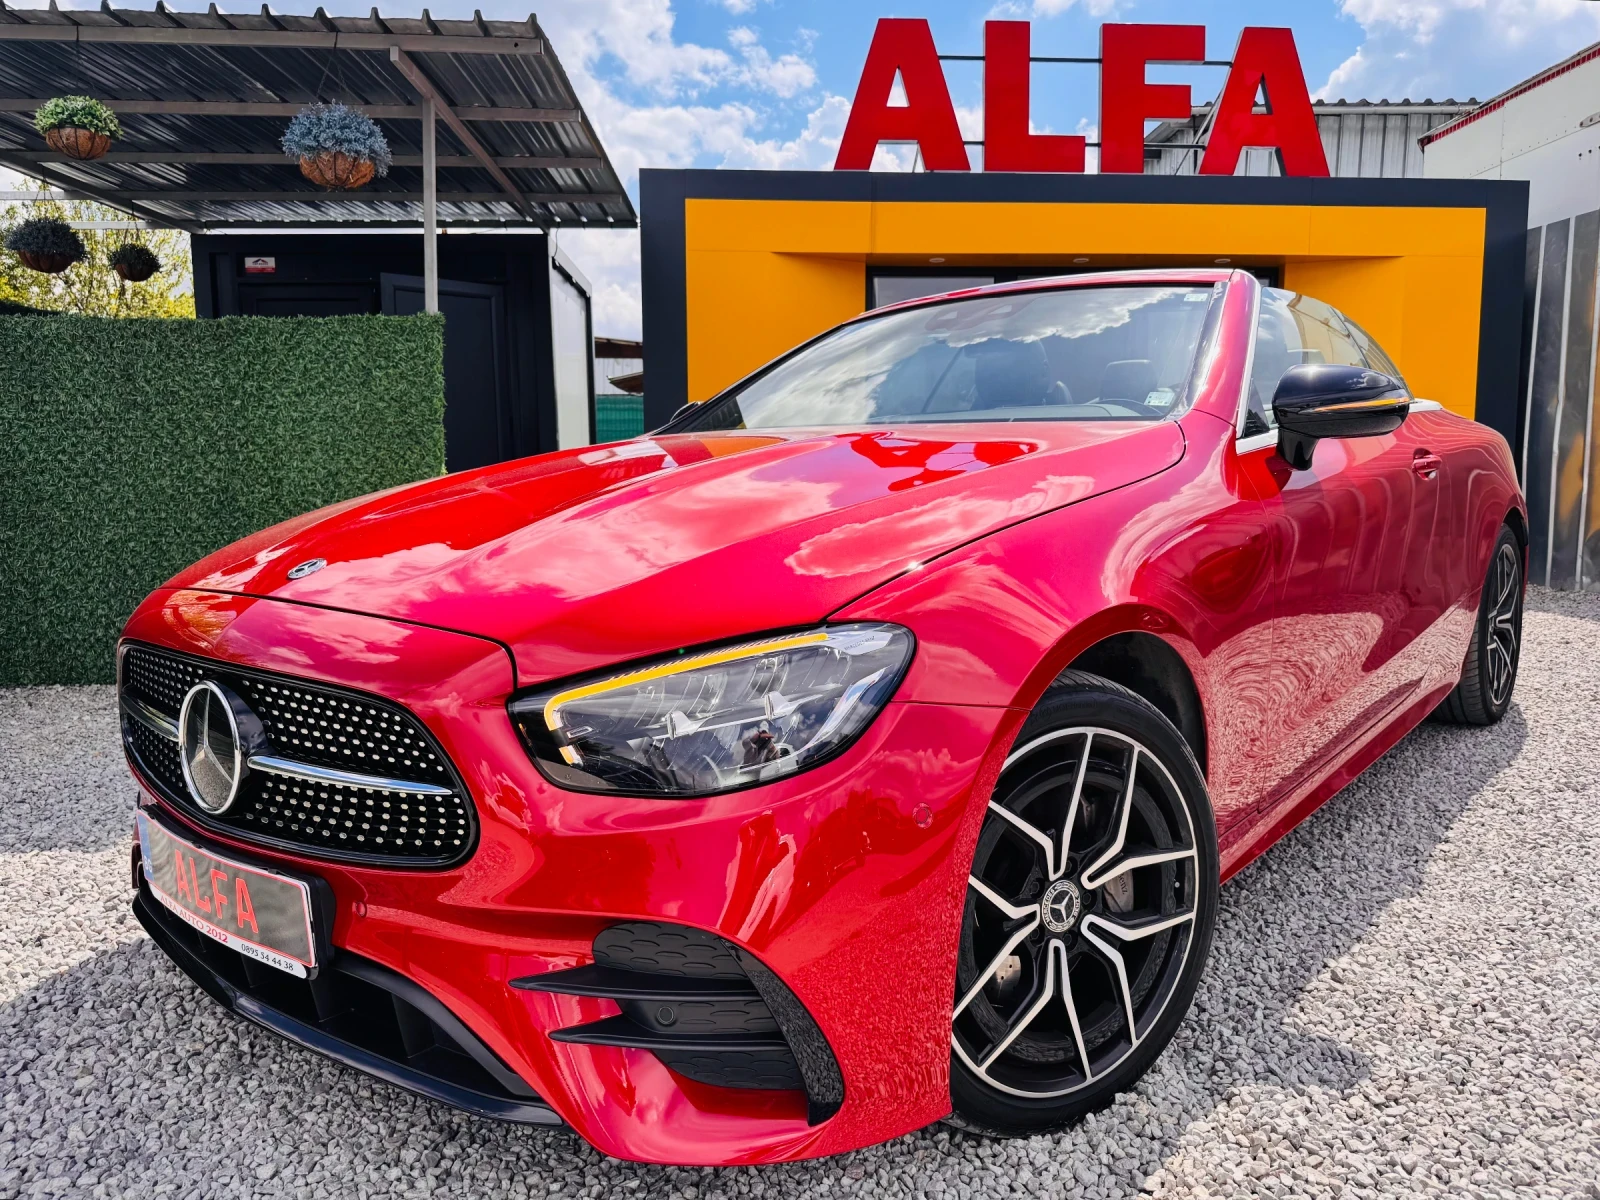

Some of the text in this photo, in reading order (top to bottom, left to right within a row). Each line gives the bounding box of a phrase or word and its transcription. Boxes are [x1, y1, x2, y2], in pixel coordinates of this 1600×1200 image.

[834, 18, 1330, 177] ALFA
[175, 849, 259, 933] ALFA
[160, 895, 294, 972] ALFA AUTO 2012 0895 54 44 38
